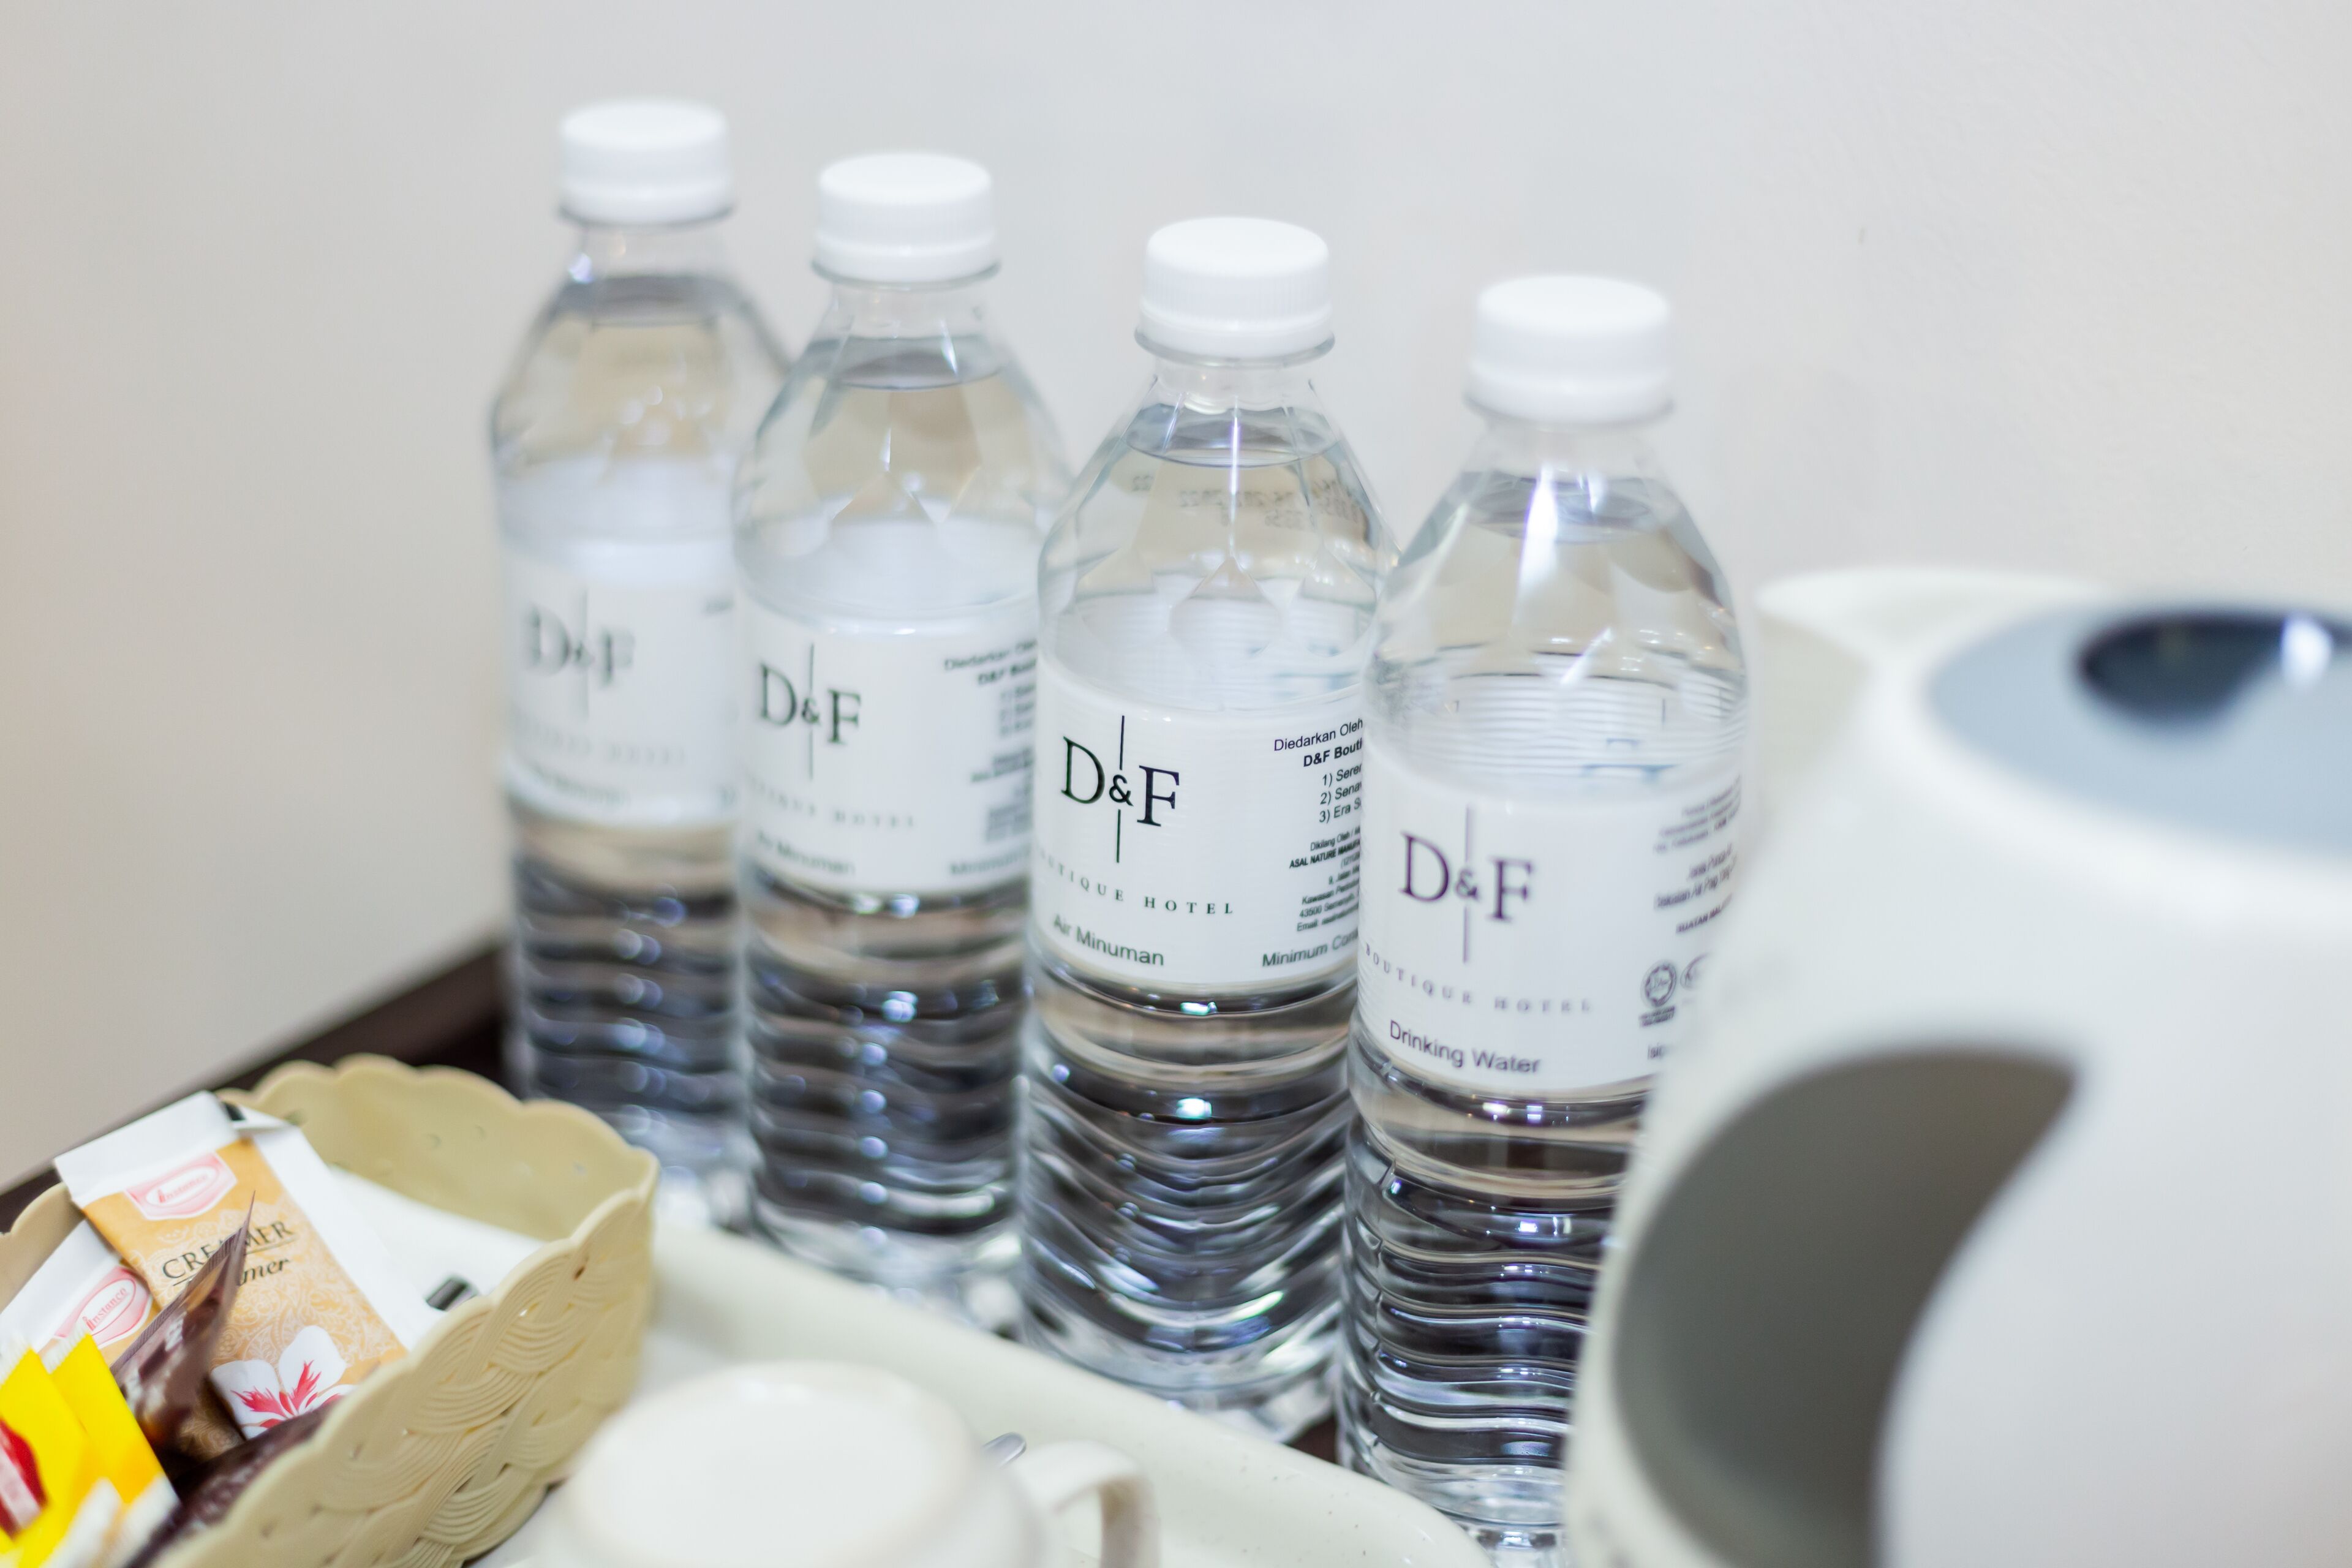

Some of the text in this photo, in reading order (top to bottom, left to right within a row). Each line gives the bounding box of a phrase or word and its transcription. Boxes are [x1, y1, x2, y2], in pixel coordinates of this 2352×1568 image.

[759, 662, 862, 745] D&F
[1274, 718, 1363, 752] Diedarkan Oleh
[1303, 749, 1330, 767] D&F
[1061, 736, 1180, 827] D&F
[1322, 773, 1333, 788] 1)
[1320, 791, 1332, 805] 2)
[1319, 809, 1330, 824] 3)
[1333, 804, 1351, 819] Era
[1289, 857, 1308, 869] ASAL
[1311, 848, 1336, 864] NATURE
[1399, 832, 1535, 922] D&F
[1144, 896, 1234, 914] HOTEL
[1302, 890, 1334, 905] Kawasan
[1054, 913, 1164, 966] Air Minuman
[1262, 943, 1328, 967] Minimum
[1366, 943, 1591, 1013] BOUTIQUE HOTEL
[1390, 1019, 1542, 1074] Drinking Water
[162, 1220, 294, 1280] CREMER
[241, 1257, 292, 1287] mer
